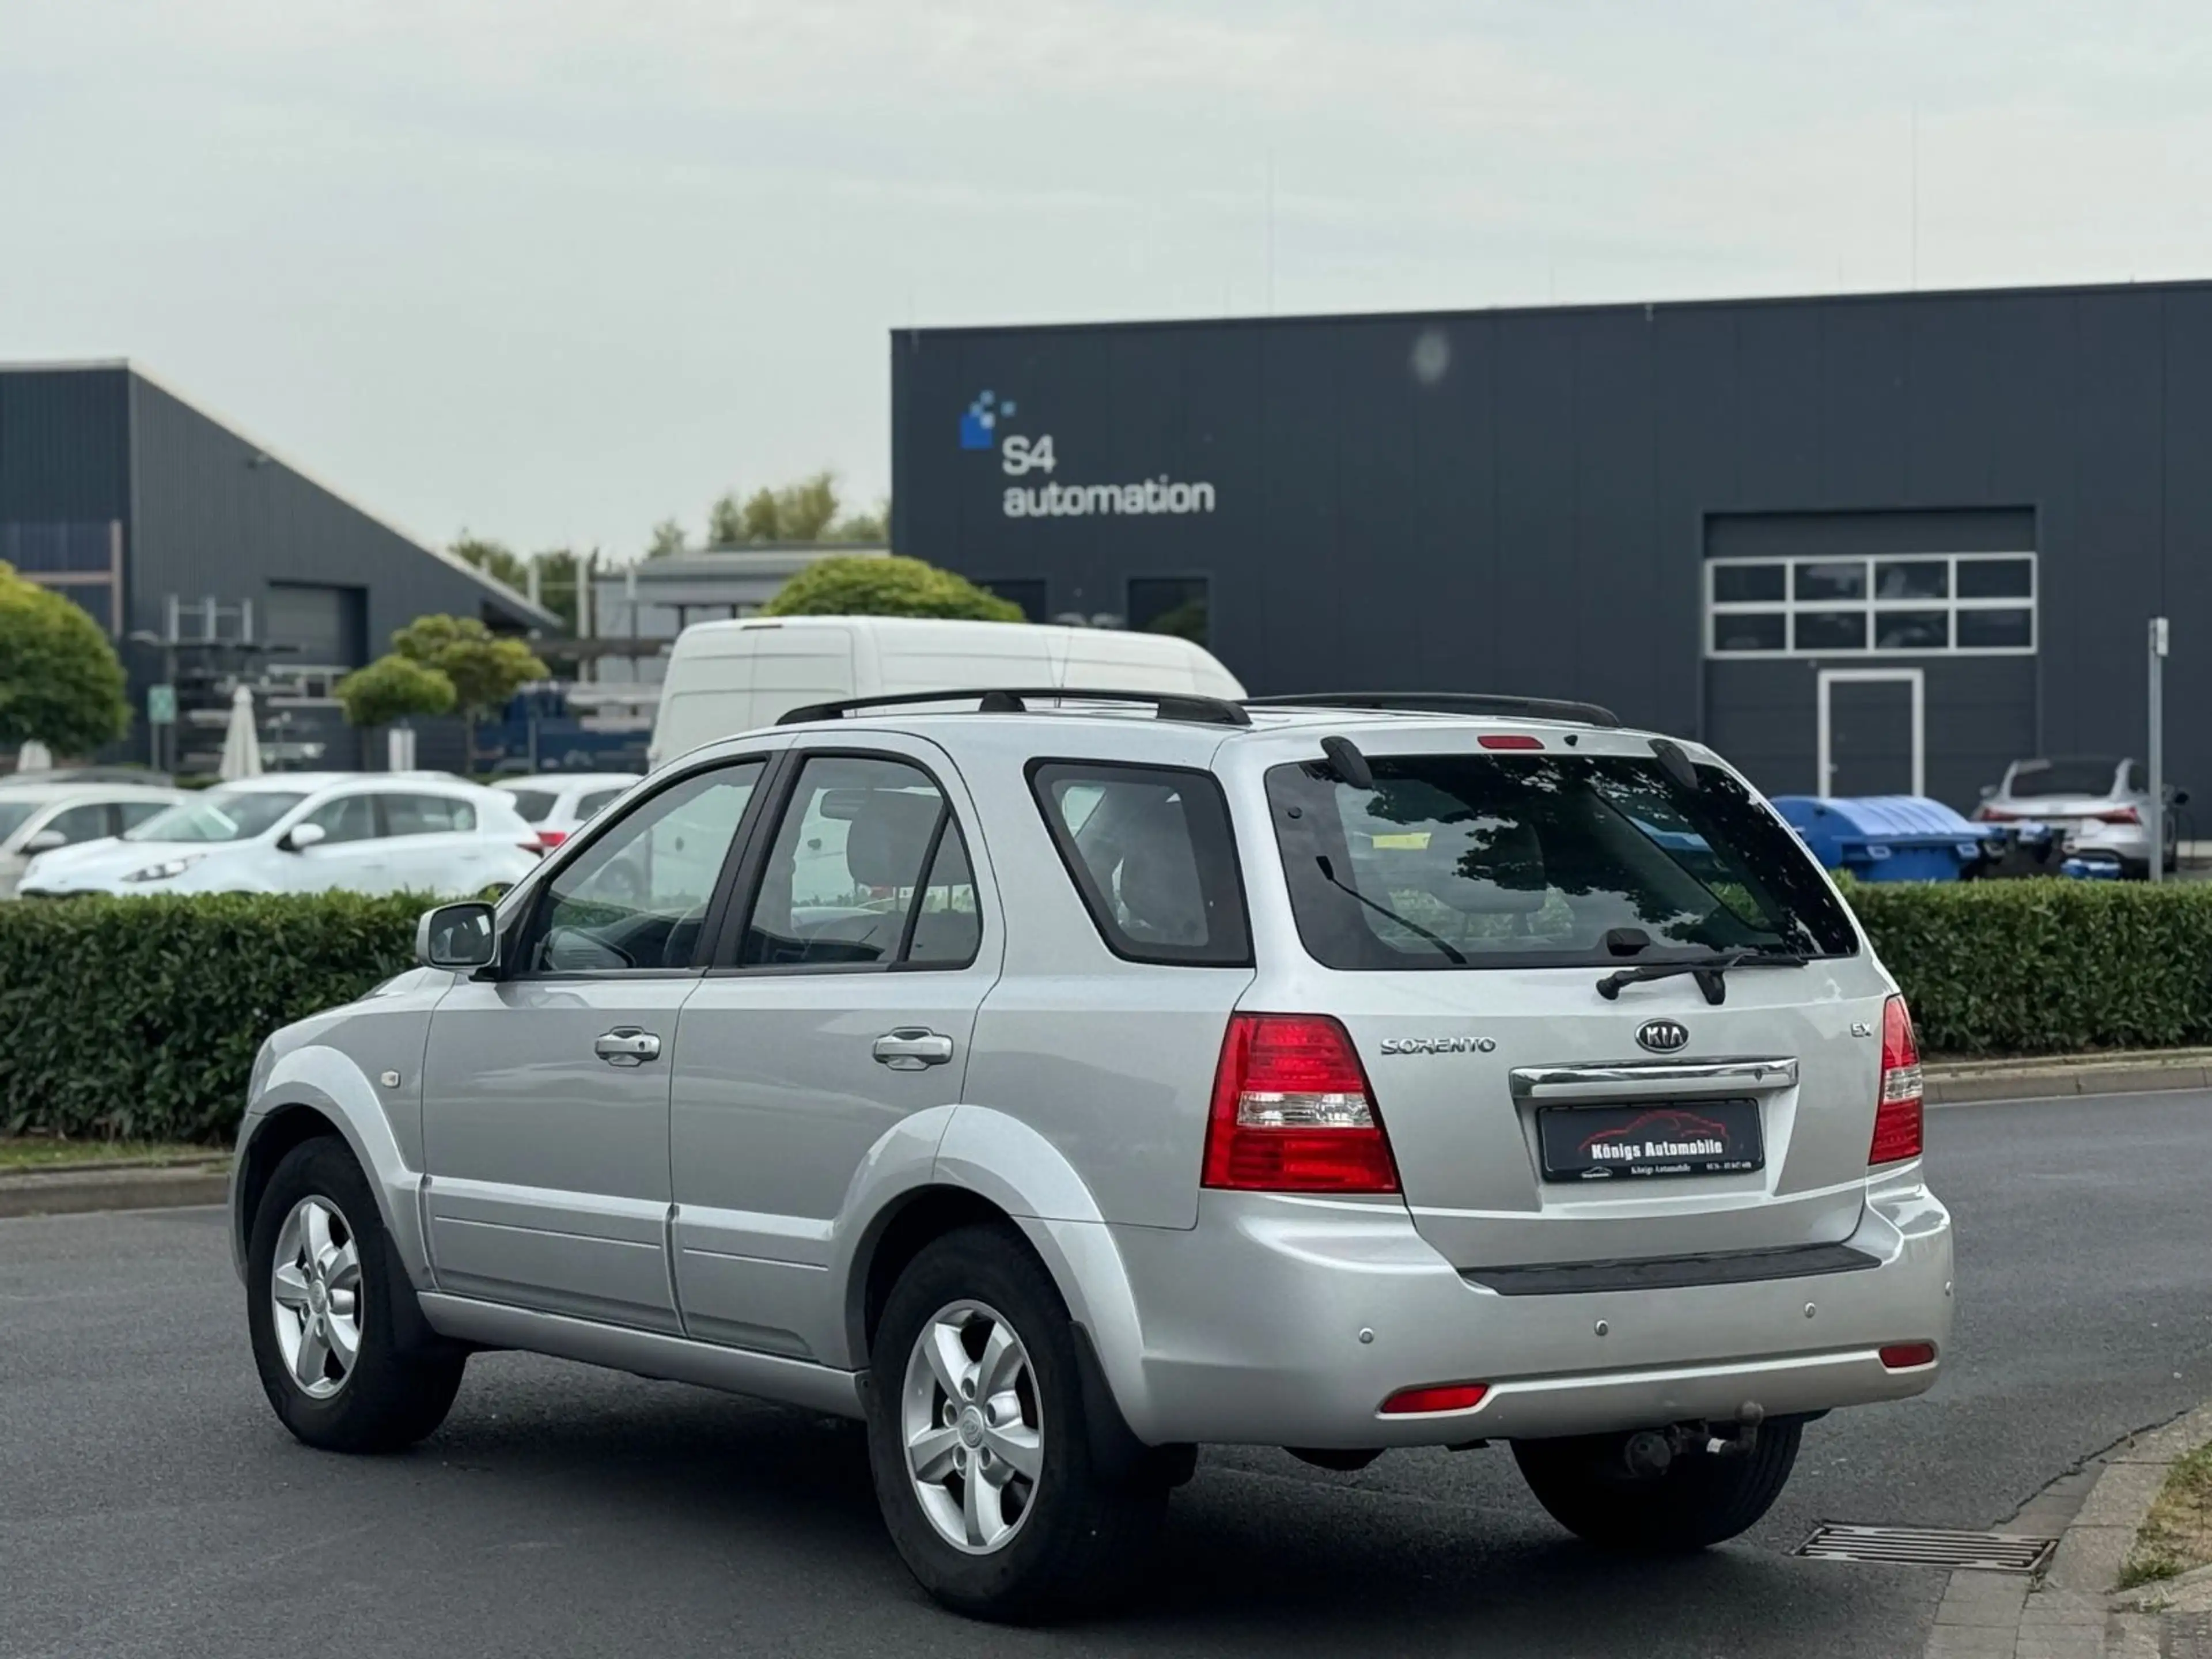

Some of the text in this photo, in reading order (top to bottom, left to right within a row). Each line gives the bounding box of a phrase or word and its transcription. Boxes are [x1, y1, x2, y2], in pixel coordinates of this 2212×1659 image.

[1002, 434, 1055, 475] S4
[1003, 474, 1215, 517] automation
[1381, 1037, 1497, 1055] SORENTO
[1646, 1026, 1683, 1046] KIA
[1645, 1139, 1722, 1157] Automobile
